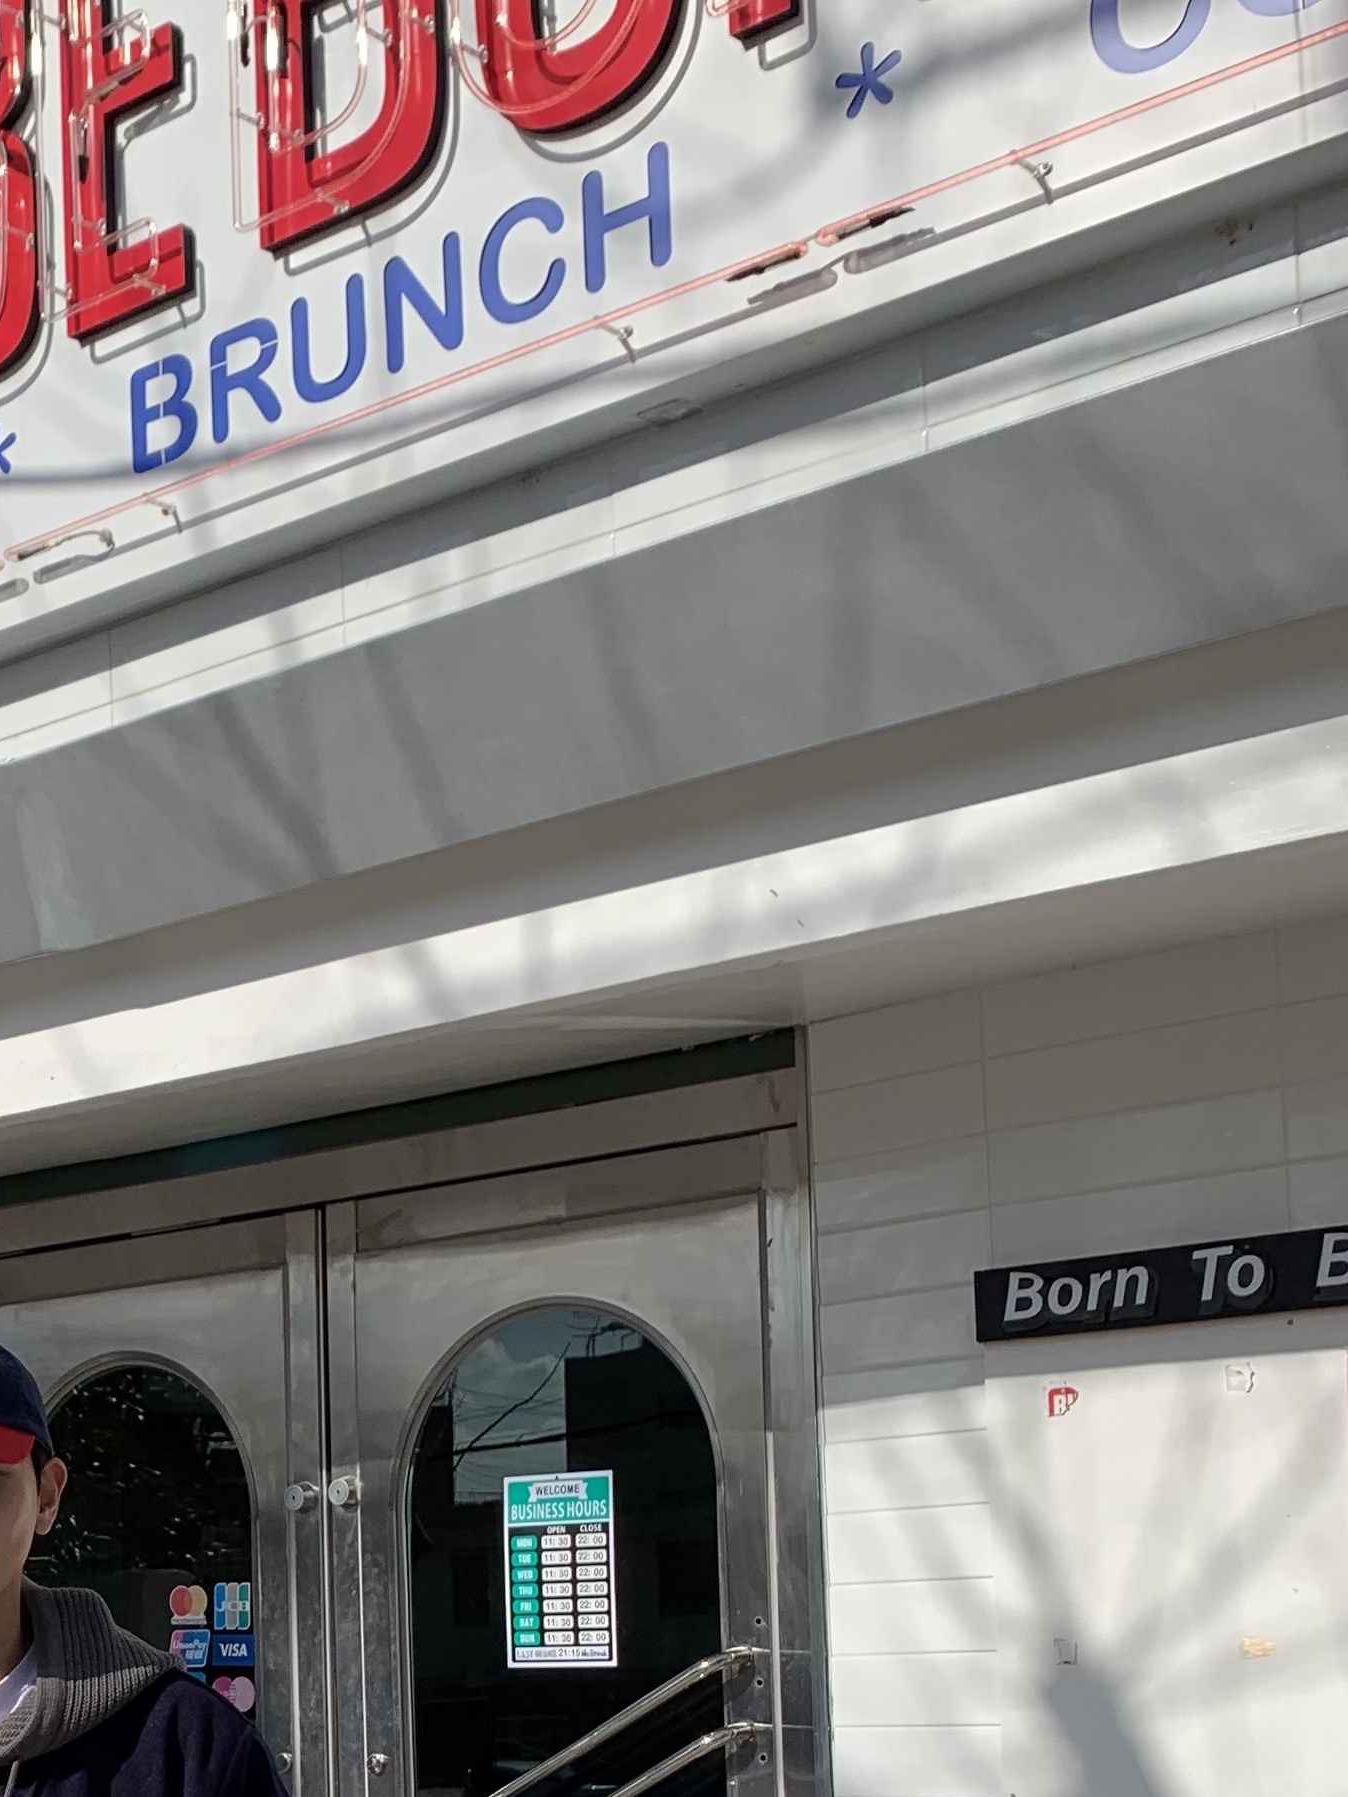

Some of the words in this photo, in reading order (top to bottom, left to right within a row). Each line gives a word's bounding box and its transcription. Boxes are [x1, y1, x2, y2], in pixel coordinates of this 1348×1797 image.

[131, 141, 671, 474] BRUNCH
[1003, 1264, 1150, 1323] Born
[1191, 1244, 1266, 1302] To
[535, 1483, 580, 1496] WELCOME
[511, 1501, 565, 1520] BUSINESS
[566, 1499, 607, 1518] HOURS
[546, 1525, 566, 1535] OPEN
[579, 1523, 602, 1533] CLOSE
[218, 1643, 248, 1657] VISA
[558, 1648, 581, 1657] 21:15
